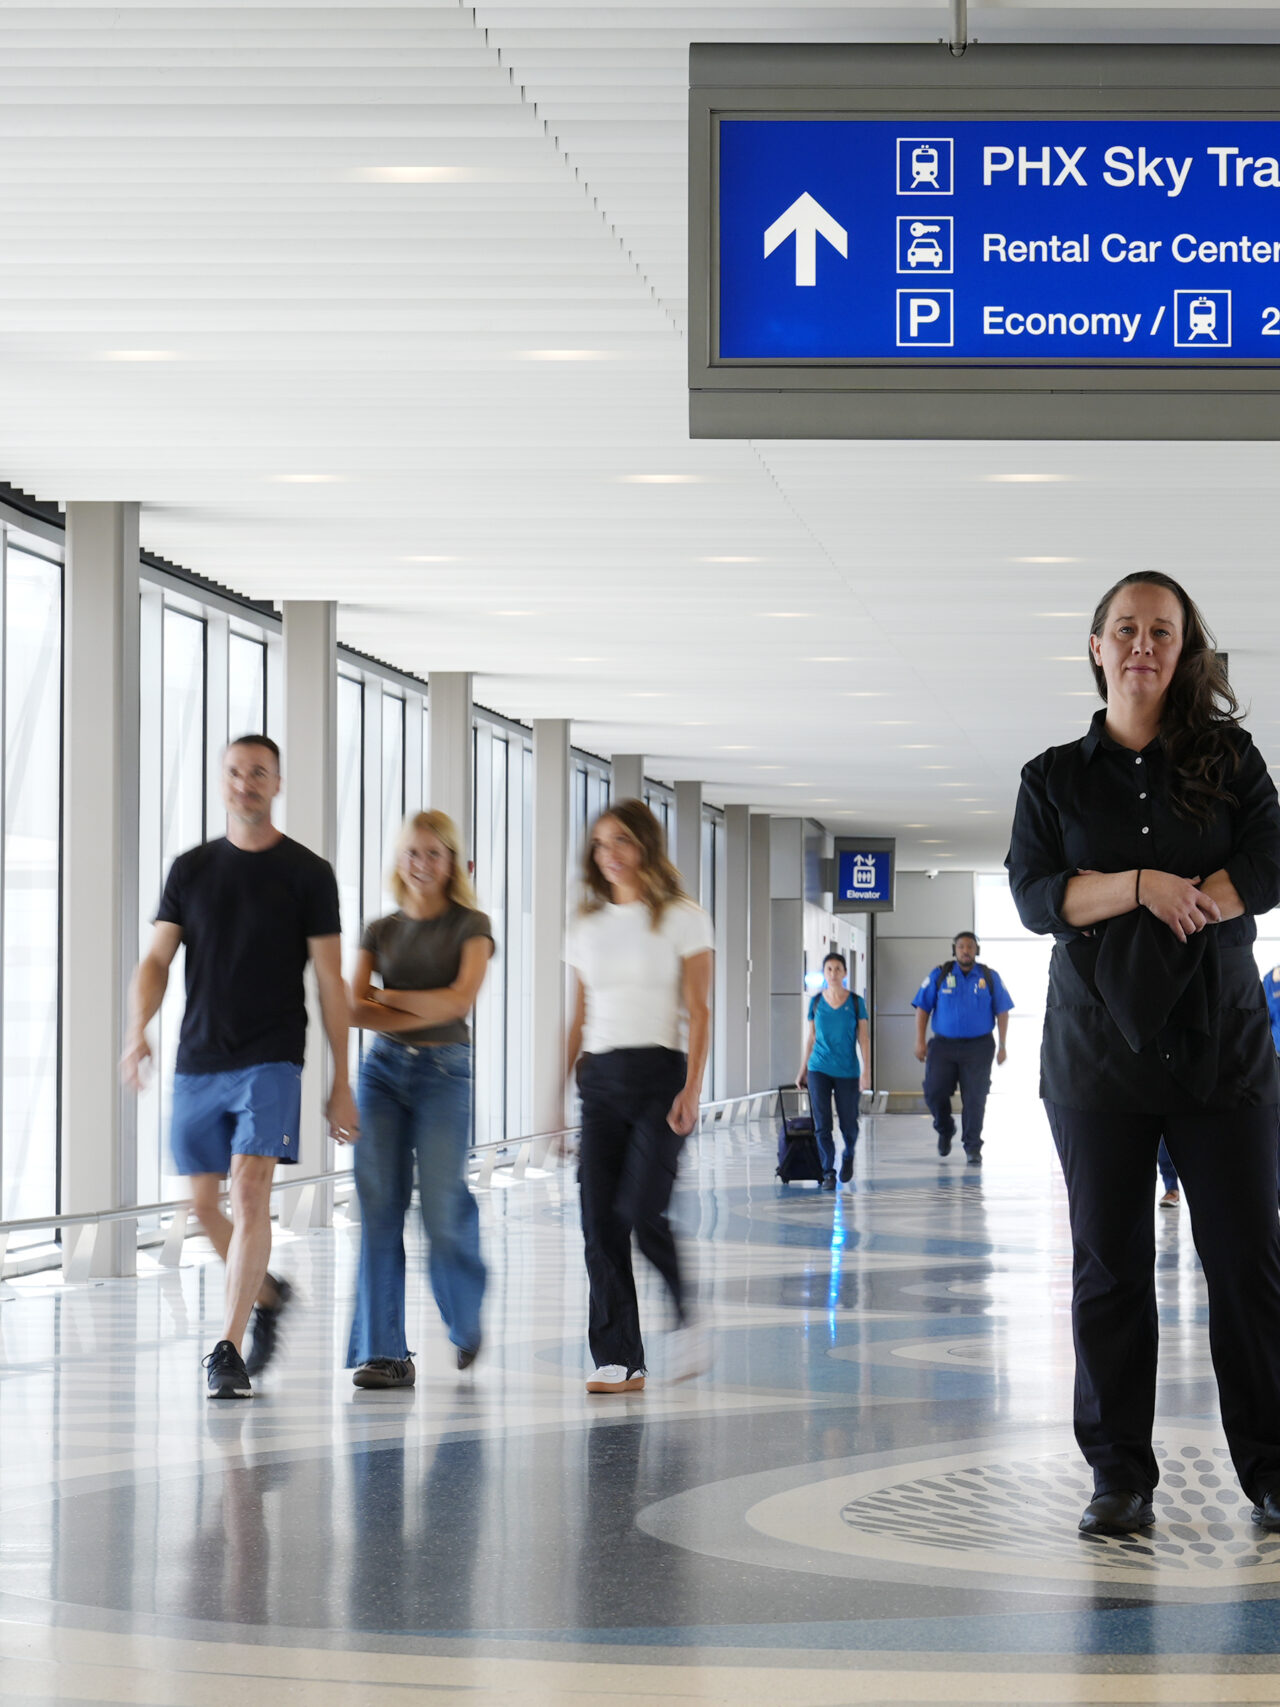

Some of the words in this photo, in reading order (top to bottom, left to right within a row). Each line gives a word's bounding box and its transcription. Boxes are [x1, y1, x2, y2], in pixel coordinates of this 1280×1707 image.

[983, 146, 1088, 187] PHX
[1102, 145, 1193, 198] Sky
[983, 233, 1090, 264] Rental
[1101, 233, 1163, 264] Car
[983, 306, 1142, 343] Economy
[846, 889, 881, 899] Elevator
